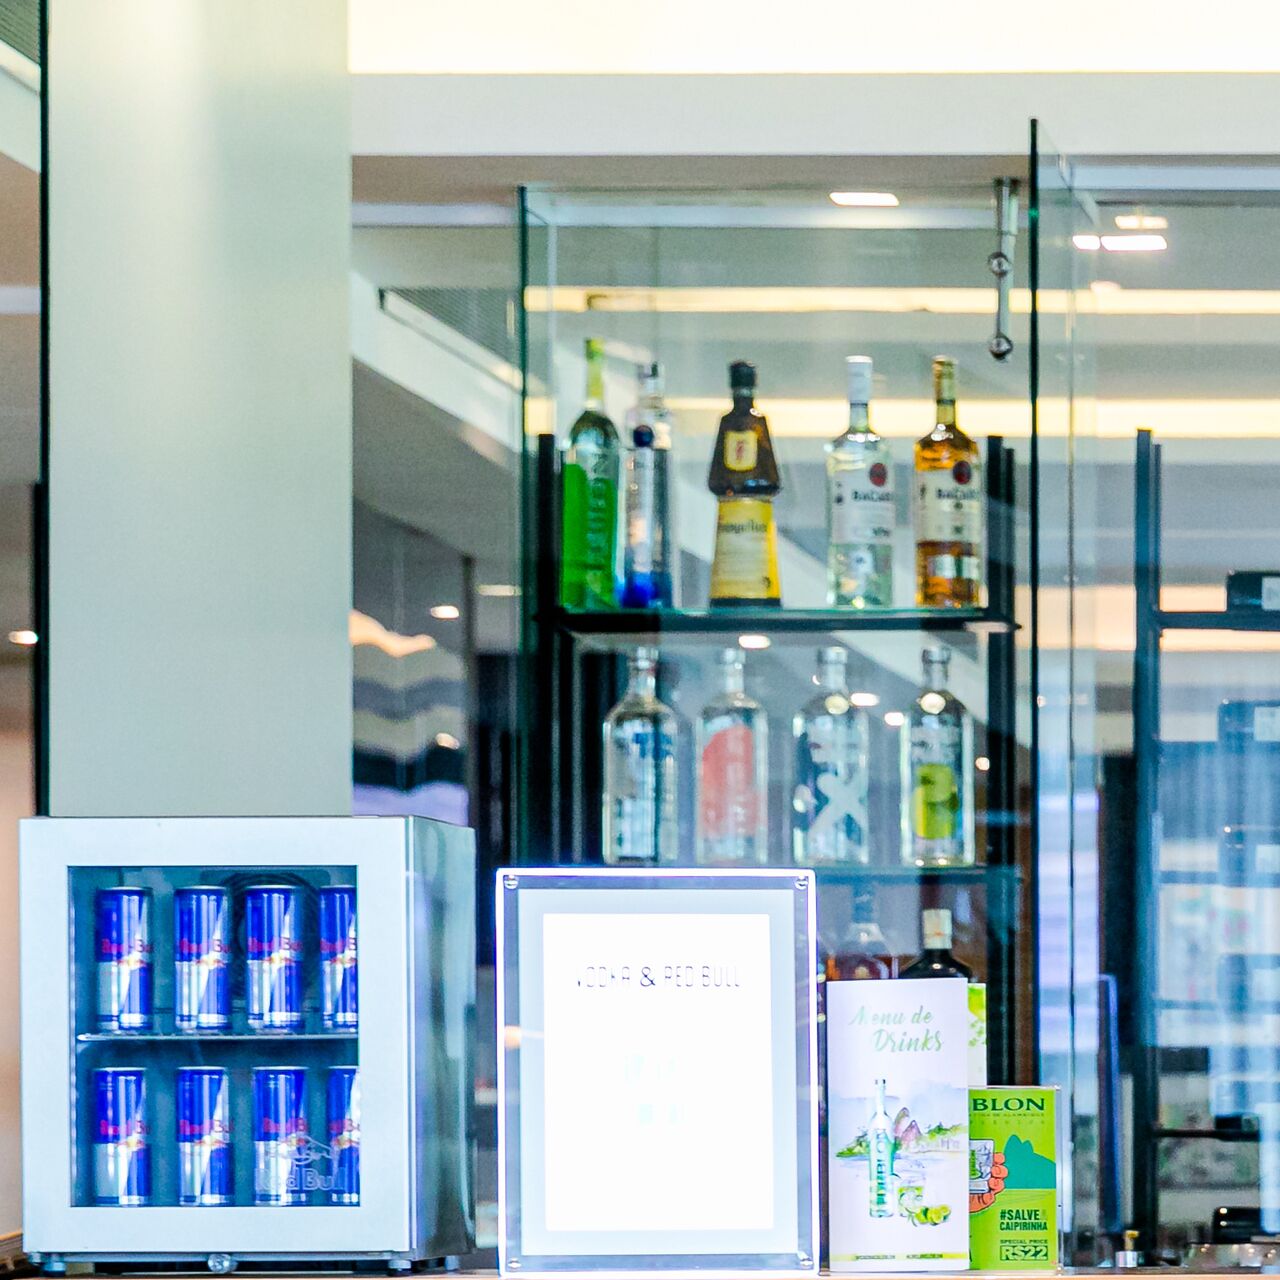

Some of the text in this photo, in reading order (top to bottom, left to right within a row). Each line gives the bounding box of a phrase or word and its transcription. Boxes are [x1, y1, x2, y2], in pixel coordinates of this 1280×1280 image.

[577, 965, 740, 988] ODKA & RED BULL
[911, 1004, 933, 1025] de
[872, 1028, 944, 1053] Drinks
[999, 1221, 1048, 1231] CAIPIRINHA
